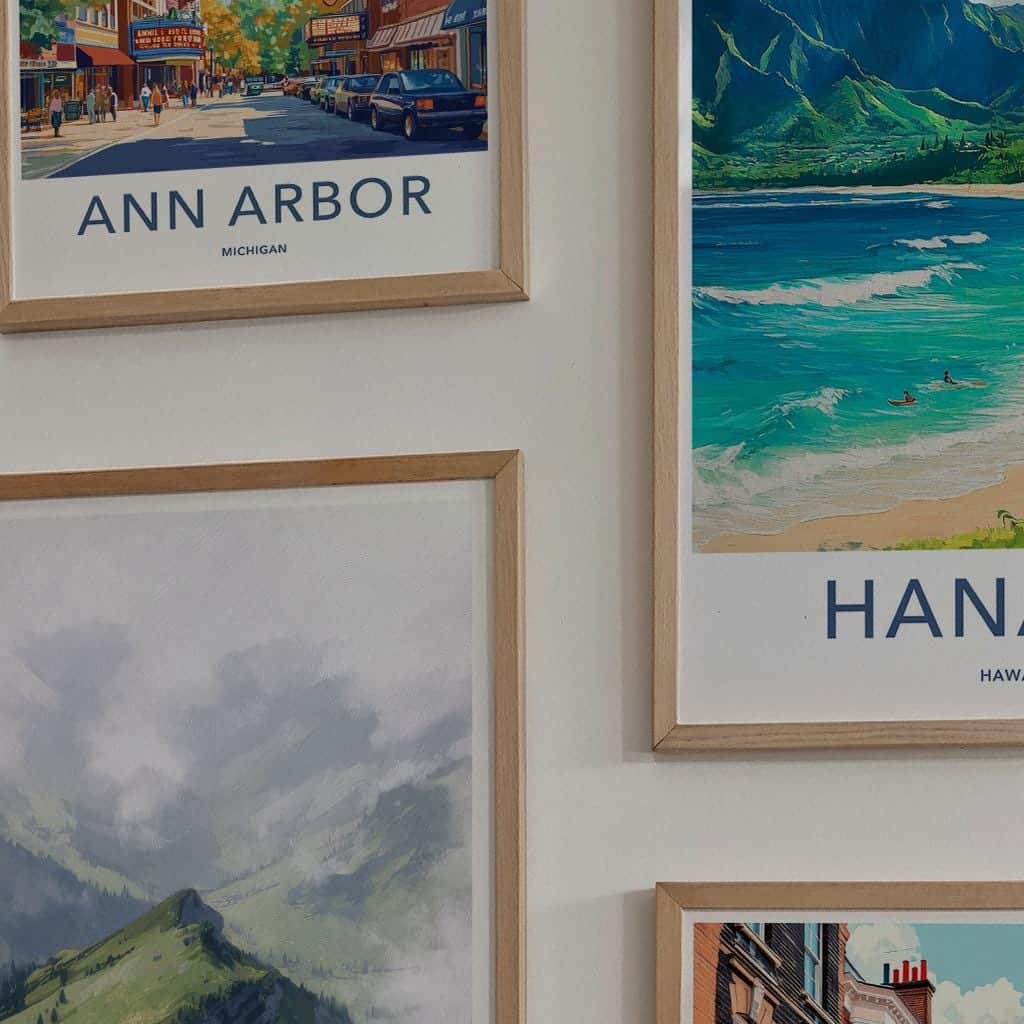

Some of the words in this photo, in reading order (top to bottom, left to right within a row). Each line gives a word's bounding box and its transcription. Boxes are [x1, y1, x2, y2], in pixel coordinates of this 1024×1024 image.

[77, 188, 205, 236] ANN
[228, 175, 432, 227] ARBOR
[221, 243, 288, 257] MICHIGAN
[826, 577, 1024, 640] HAN
[979, 668, 1024, 683] HAW
